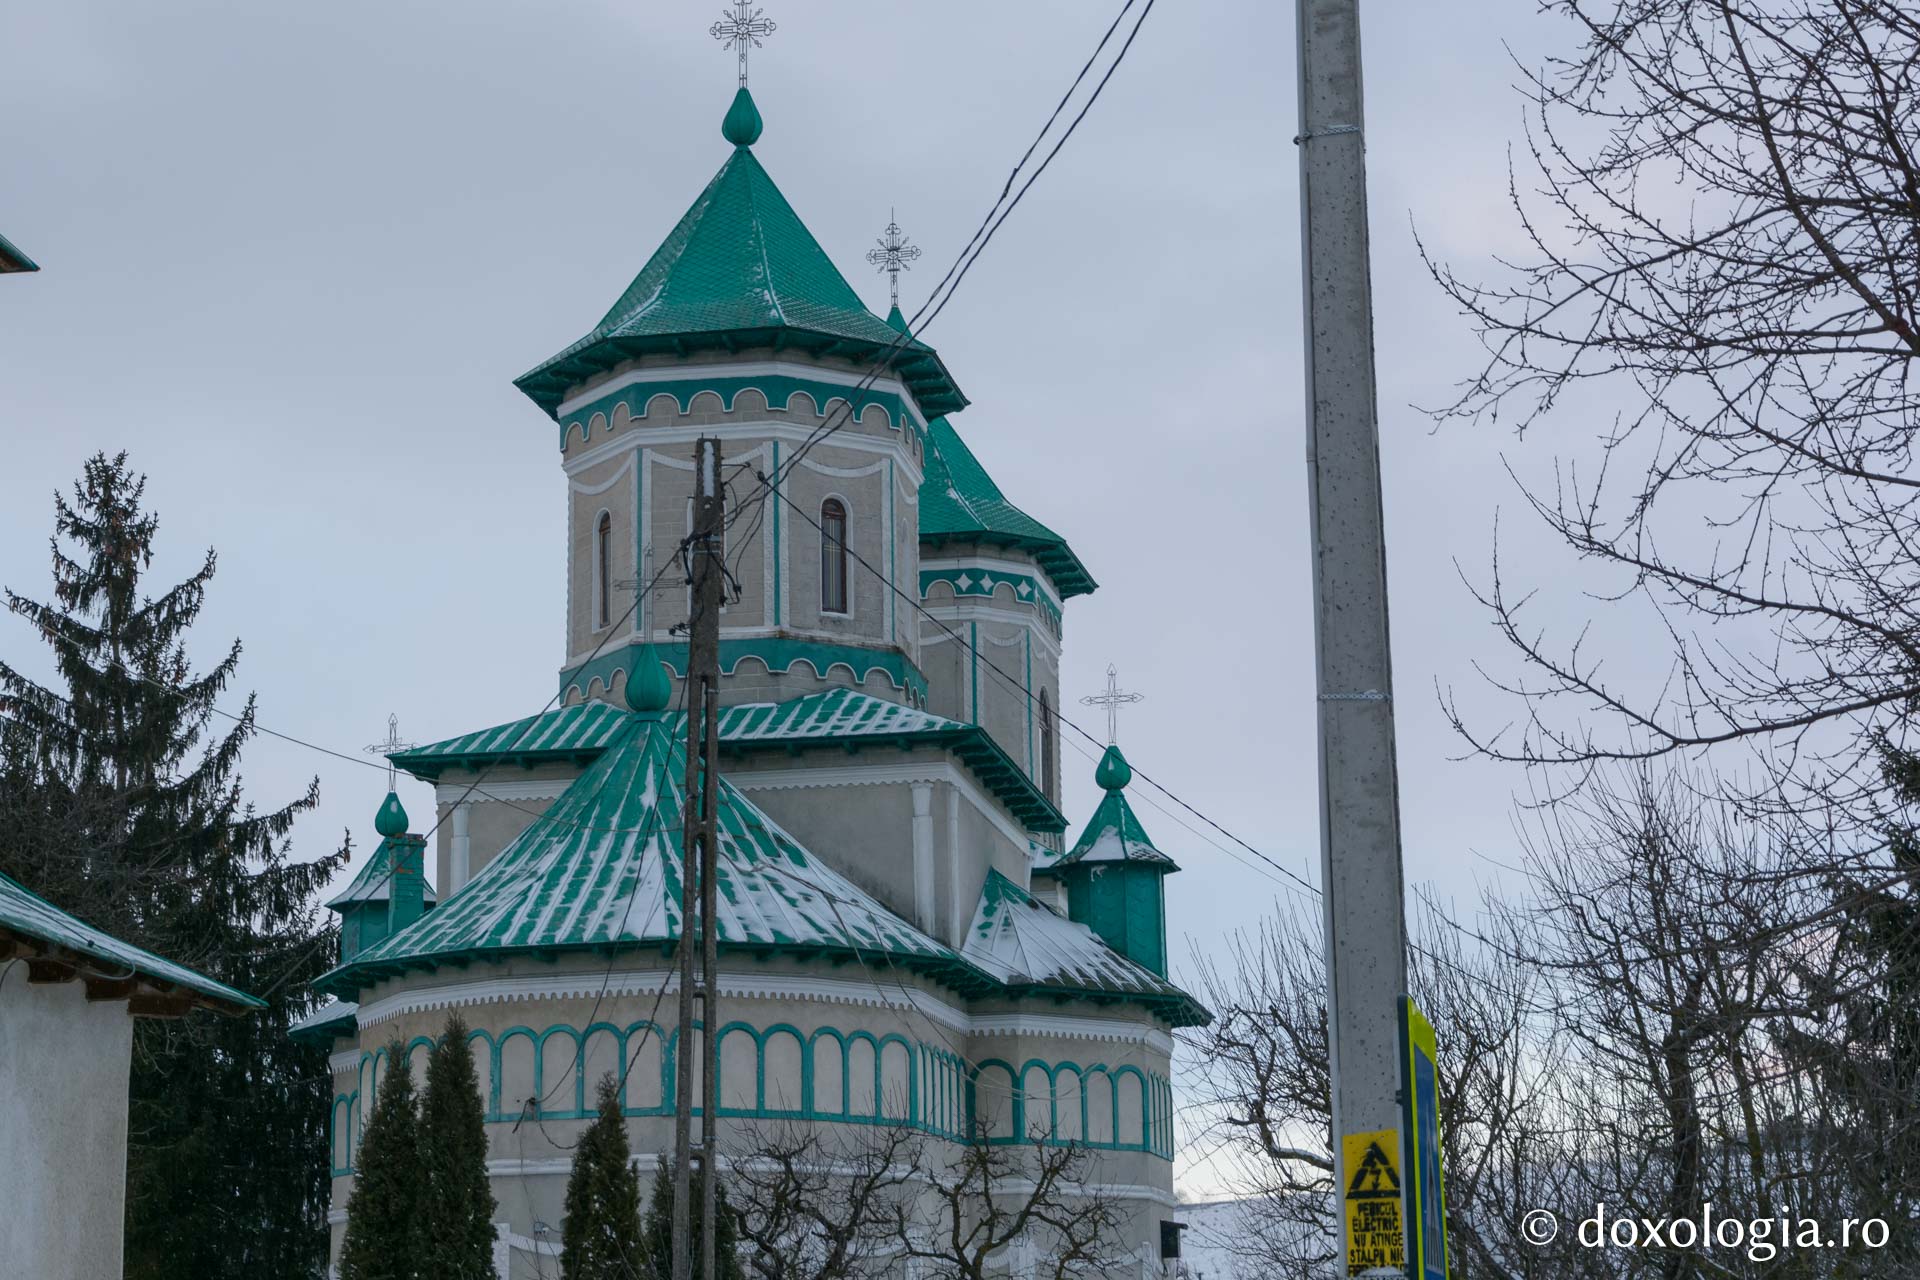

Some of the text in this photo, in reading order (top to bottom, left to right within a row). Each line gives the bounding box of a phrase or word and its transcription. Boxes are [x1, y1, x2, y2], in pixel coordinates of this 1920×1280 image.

[1357, 1202, 1398, 1216] PERICUL
[1352, 1216, 1398, 1232] ELECTRIC
[1354, 1233, 1366, 1247] NU
